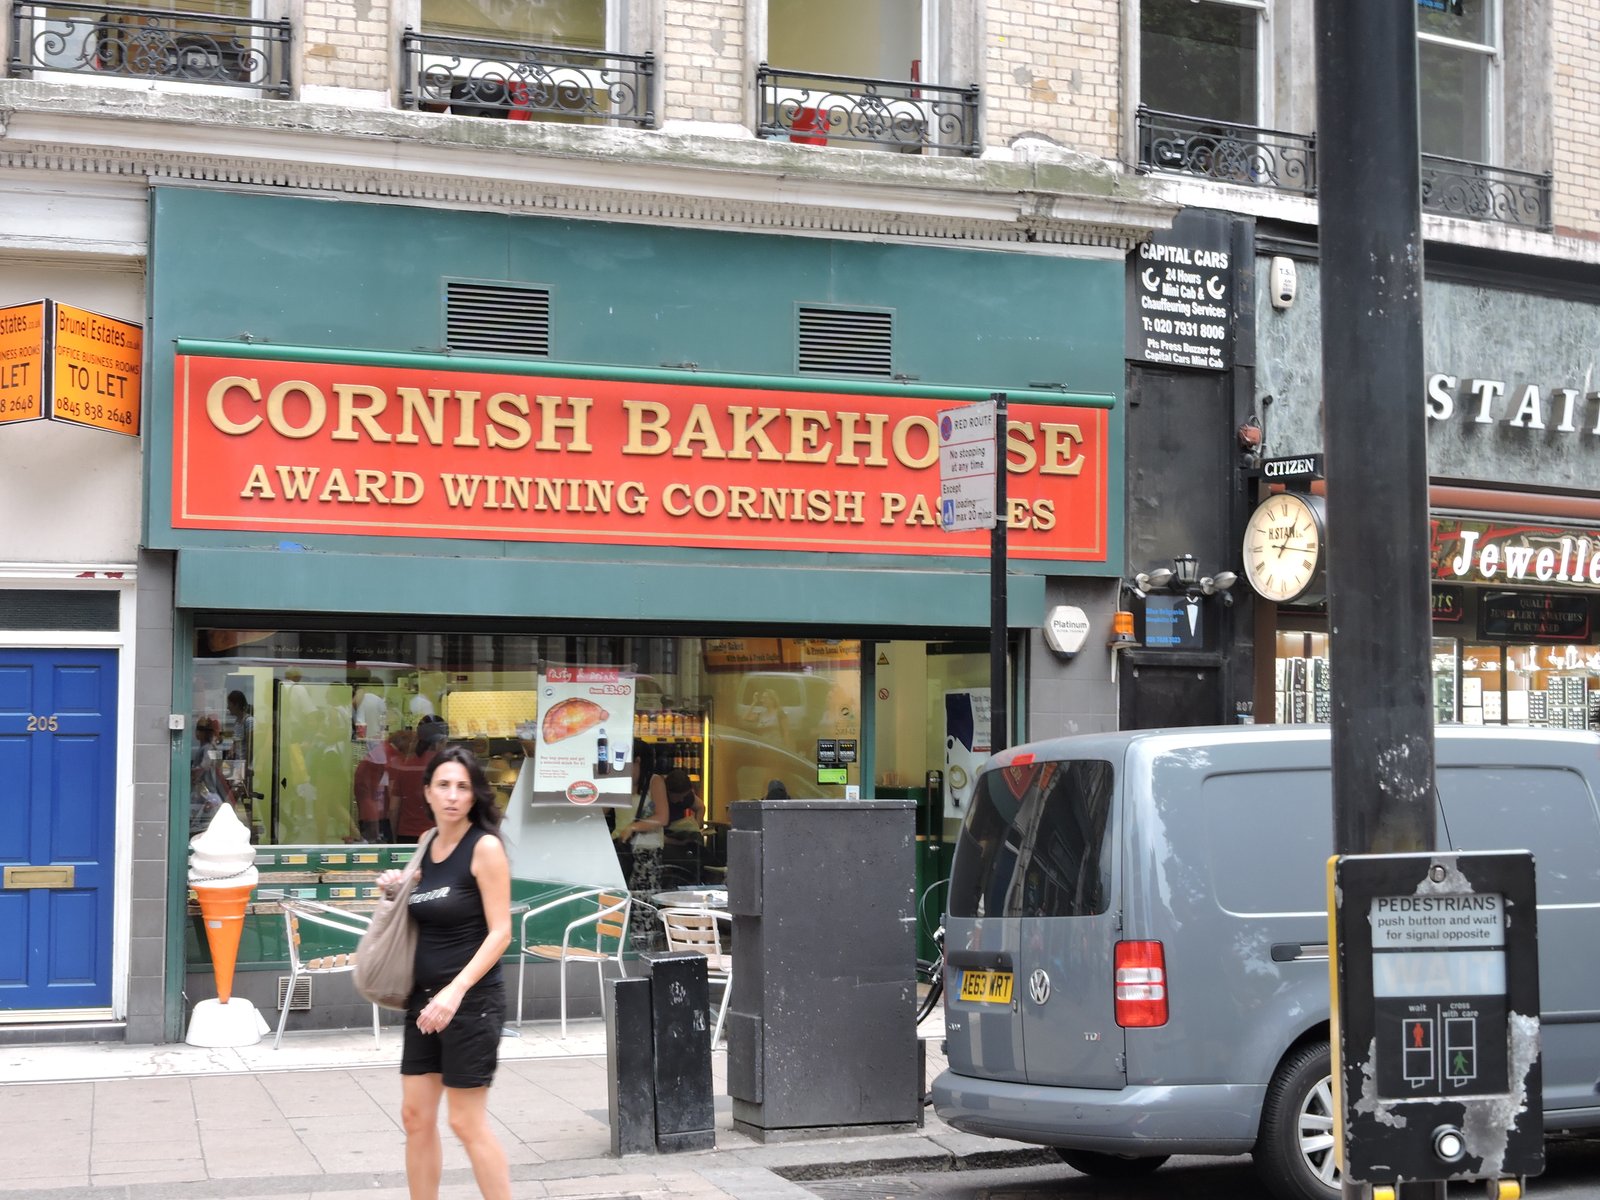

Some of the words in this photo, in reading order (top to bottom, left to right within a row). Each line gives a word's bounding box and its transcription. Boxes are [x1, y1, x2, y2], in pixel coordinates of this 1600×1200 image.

[1140, 242, 1192, 265] CAPITAL
[1194, 249, 1229, 270] CARS
[1165, 267, 1177, 282] 24
[1178, 269, 1202, 285] Hours
[1162, 282, 1179, 298] Mini
[1180, 285, 1196, 300] Cab
[1197, 287, 1205, 300] &
[1141, 295, 1191, 317] Chauffeuring
[1191, 301, 1227, 319] Services
[60, 310, 89, 338] Brunel
[1142, 316, 1153, 332] T:
[1154, 318, 1173, 334] 020
[1174, 320, 1198, 337] 7931
[1200, 323, 1225, 340] 8006
[1160, 340, 1182, 352] Press
[1183, 342, 1209, 355] Buzzer
[1209, 345, 1222, 357] for
[57, 345, 80, 361] OFFICE
[82, 352, 113, 368] BUSINESS
[115, 360, 140, 375] ROOMS
[1145, 349, 1171, 362] Capital
[1172, 352, 1190, 365] Cars
[1191, 355, 1208, 367] Mini
[1208, 357, 1224, 369] Cab
[1, 362, 30, 389] LET
[68, 363, 90, 391] TO
[97, 371, 128, 399] LET
[10, 394, 33, 413] 2648
[56, 396, 81, 417] 0845
[84, 402, 103, 420] 838
[107, 408, 132, 427] 2648
[206, 376, 593, 454] CORNISH
[621, 399, 1086, 476] BAKEHOSE
[954, 419, 968, 430] RED
[969, 414, 993, 428] ROUTE
[949, 450, 958, 459] No
[959, 447, 986, 460] stopping
[951, 464, 957, 472] at
[958, 463, 969, 473] any
[970, 460, 985, 470] time
[1264, 458, 1315, 477] CITIZEN
[240, 464, 425, 506] AWARD
[440, 472, 649, 515] WINNING
[662, 483, 866, 525] CORNISH
[880, 491, 1057, 531] PAES
[942, 484, 962, 495] Except
[968, 510, 977, 521] 20
[1053, 620, 1087, 629] Platinum
[603, 685, 632, 696] £3.99
[26, 716, 59, 732] 205
[1378, 896, 1497, 912] PEDESTRIANS
[1378, 915, 1405, 928] push
[1408, 914, 1446, 926] button
[1449, 914, 1471, 925] and
[1472, 914, 1497, 925] wait
[1387, 929, 1402, 940] for
[1406, 929, 1440, 942] signal
[1442, 928, 1491, 942] opposite
[1381, 955, 1495, 993] WAIT
[962, 974, 987, 997] AE63
[988, 976, 1012, 998] WRT
[1408, 1003, 1427, 1012] wait
[1442, 1009, 1459, 1018] with
[1461, 1010, 1479, 1018] care
[1449, 1002, 1471, 1010] cross
